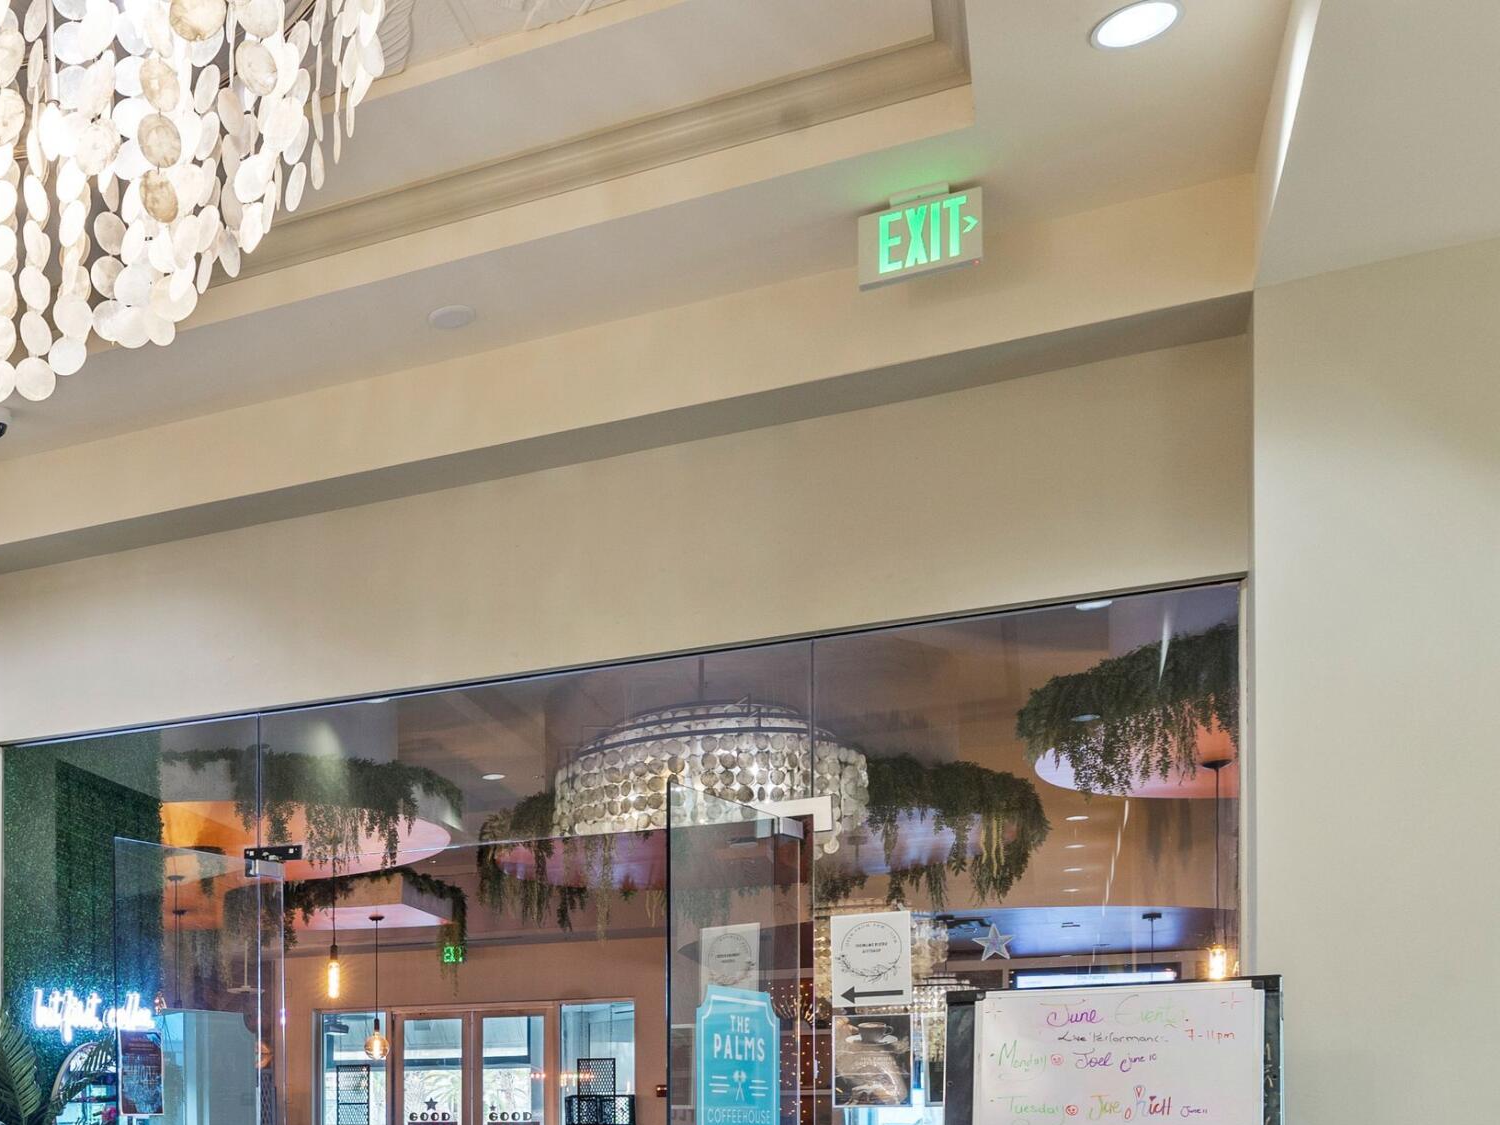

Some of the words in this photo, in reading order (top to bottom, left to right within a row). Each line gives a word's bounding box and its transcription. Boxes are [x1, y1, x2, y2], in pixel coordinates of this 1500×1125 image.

[878, 195, 968, 274] EXIT
[1041, 999, 1103, 1028] June
[730, 1014, 751, 1034] THE
[1057, 1032, 1086, 1042] Live
[713, 1033, 765, 1062] PALMS
[1073, 1048, 1113, 1069] Joel
[409, 1112, 451, 1121] GOOD
[488, 1112, 533, 1121] GOOD
[707, 1108, 771, 1125] COFFEEHOUSE
